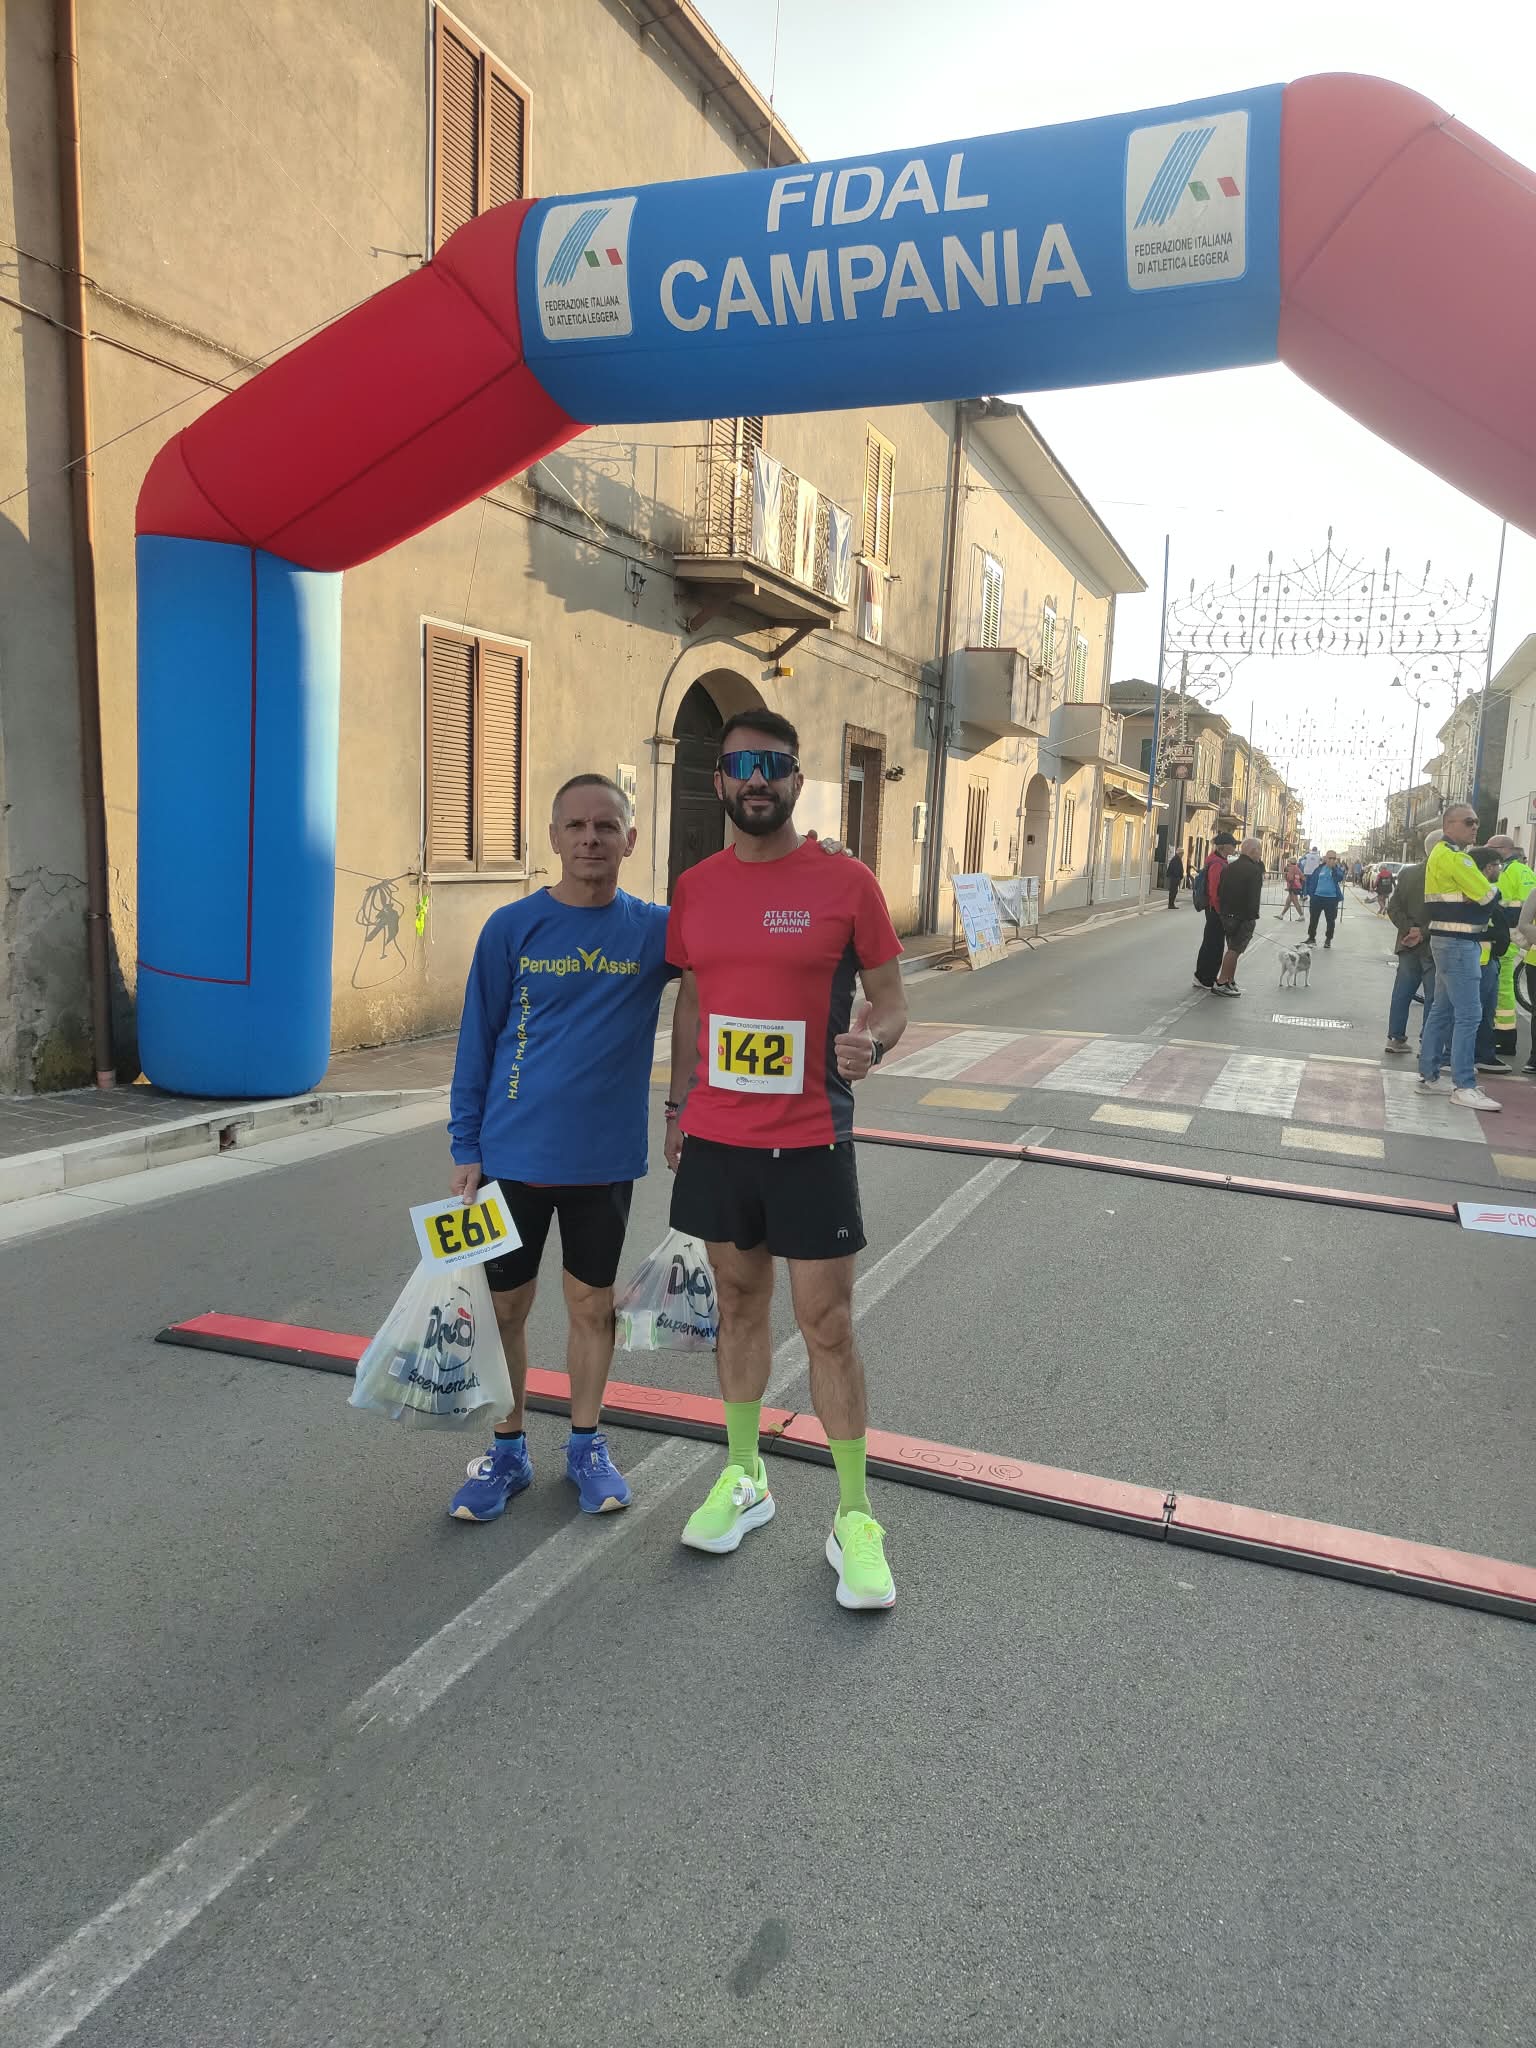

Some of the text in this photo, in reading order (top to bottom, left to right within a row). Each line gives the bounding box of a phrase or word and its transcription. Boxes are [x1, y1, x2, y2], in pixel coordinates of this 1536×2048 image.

[767, 153, 989, 233] FIDAL
[1134, 231, 1233, 257] FEDERAZIONE ITALIANA
[1137, 250, 1230, 275] DI ATLETICA LEGGERA
[660, 223, 1092, 333] CAMPANIA
[544, 295, 620, 312] FEDERAZIONE ITALIANA
[548, 310, 620, 327] DI ATLETICA LEGGERA
[762, 918, 811, 927] CAPANNE
[763, 910, 811, 919] ATLETICA
[769, 926, 803, 934] PERUGIA
[519, 955, 581, 976] Perugia
[507, 986, 532, 1100] HALF MARATHON
[722, 1030, 785, 1076] 142
[434, 1202, 501, 1254] 193
